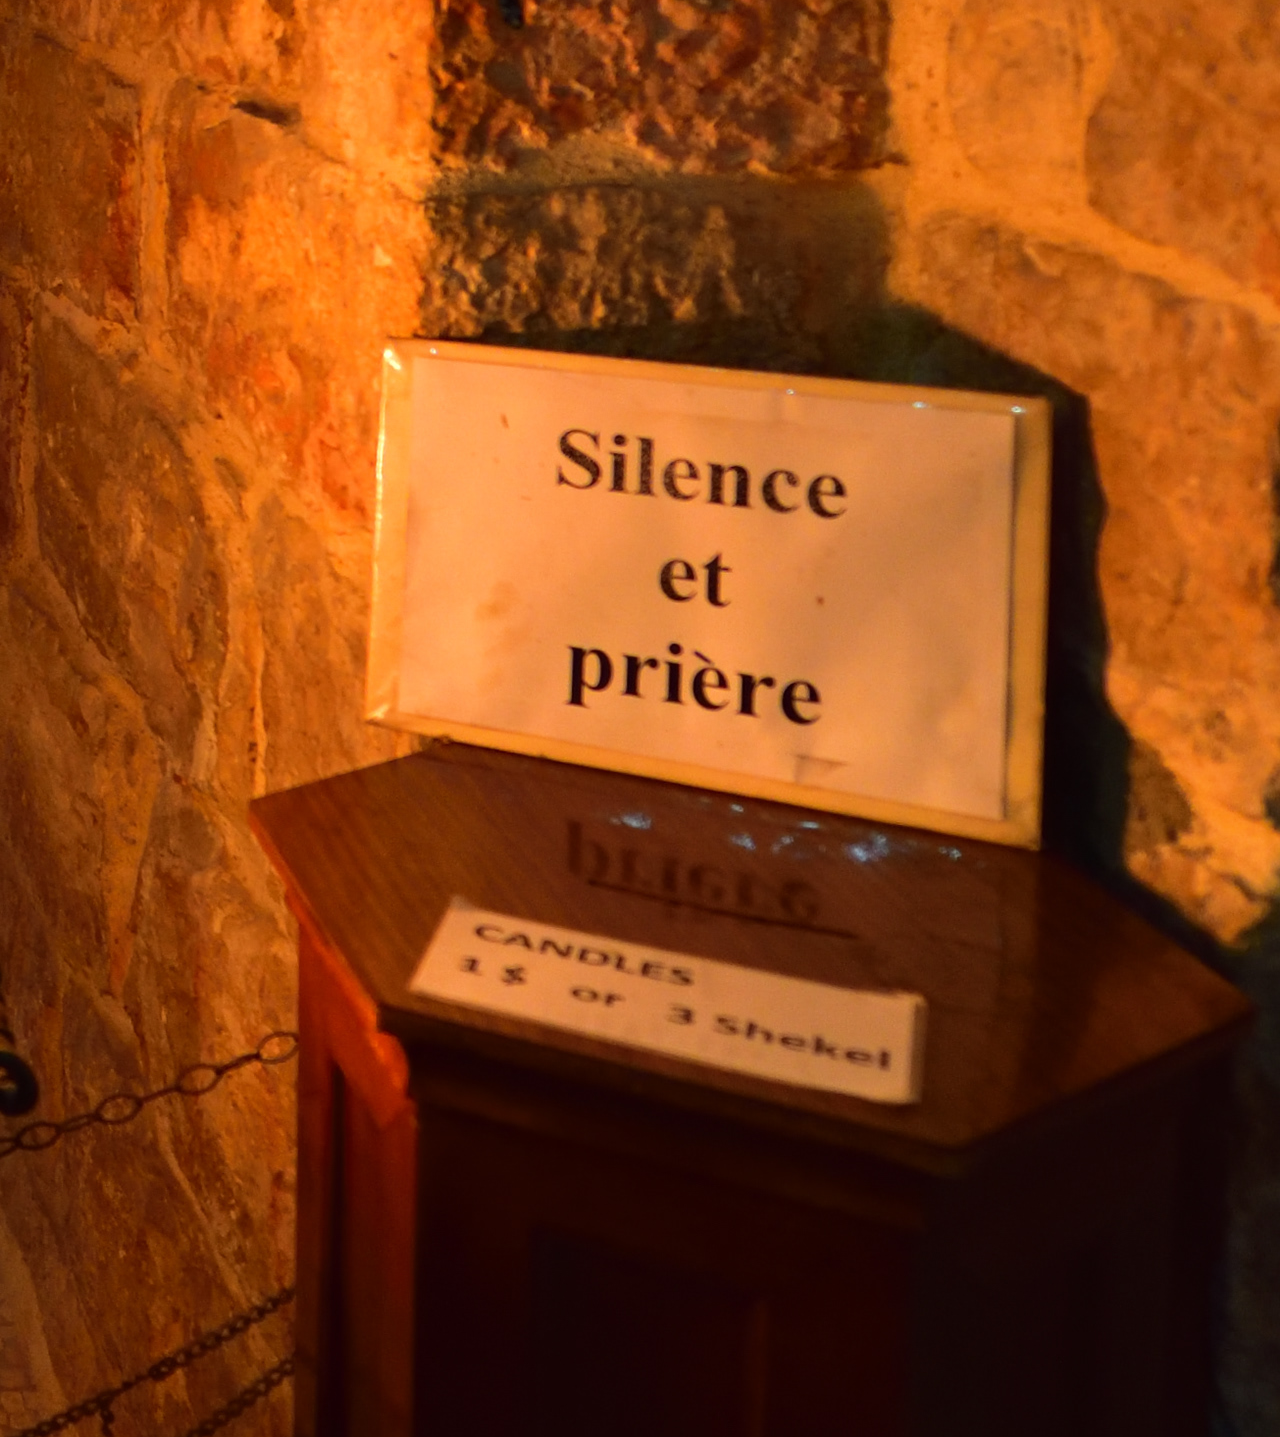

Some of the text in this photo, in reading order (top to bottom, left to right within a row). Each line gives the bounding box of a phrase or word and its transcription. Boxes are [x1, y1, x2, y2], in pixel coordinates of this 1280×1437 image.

[557, 429, 847, 520] Silence
[659, 555, 730, 607] et
[566, 642, 821, 726] prière
[472, 922, 697, 986] CANDLES
[459, 956, 891, 1073] 1 $ or 3 Shekel
